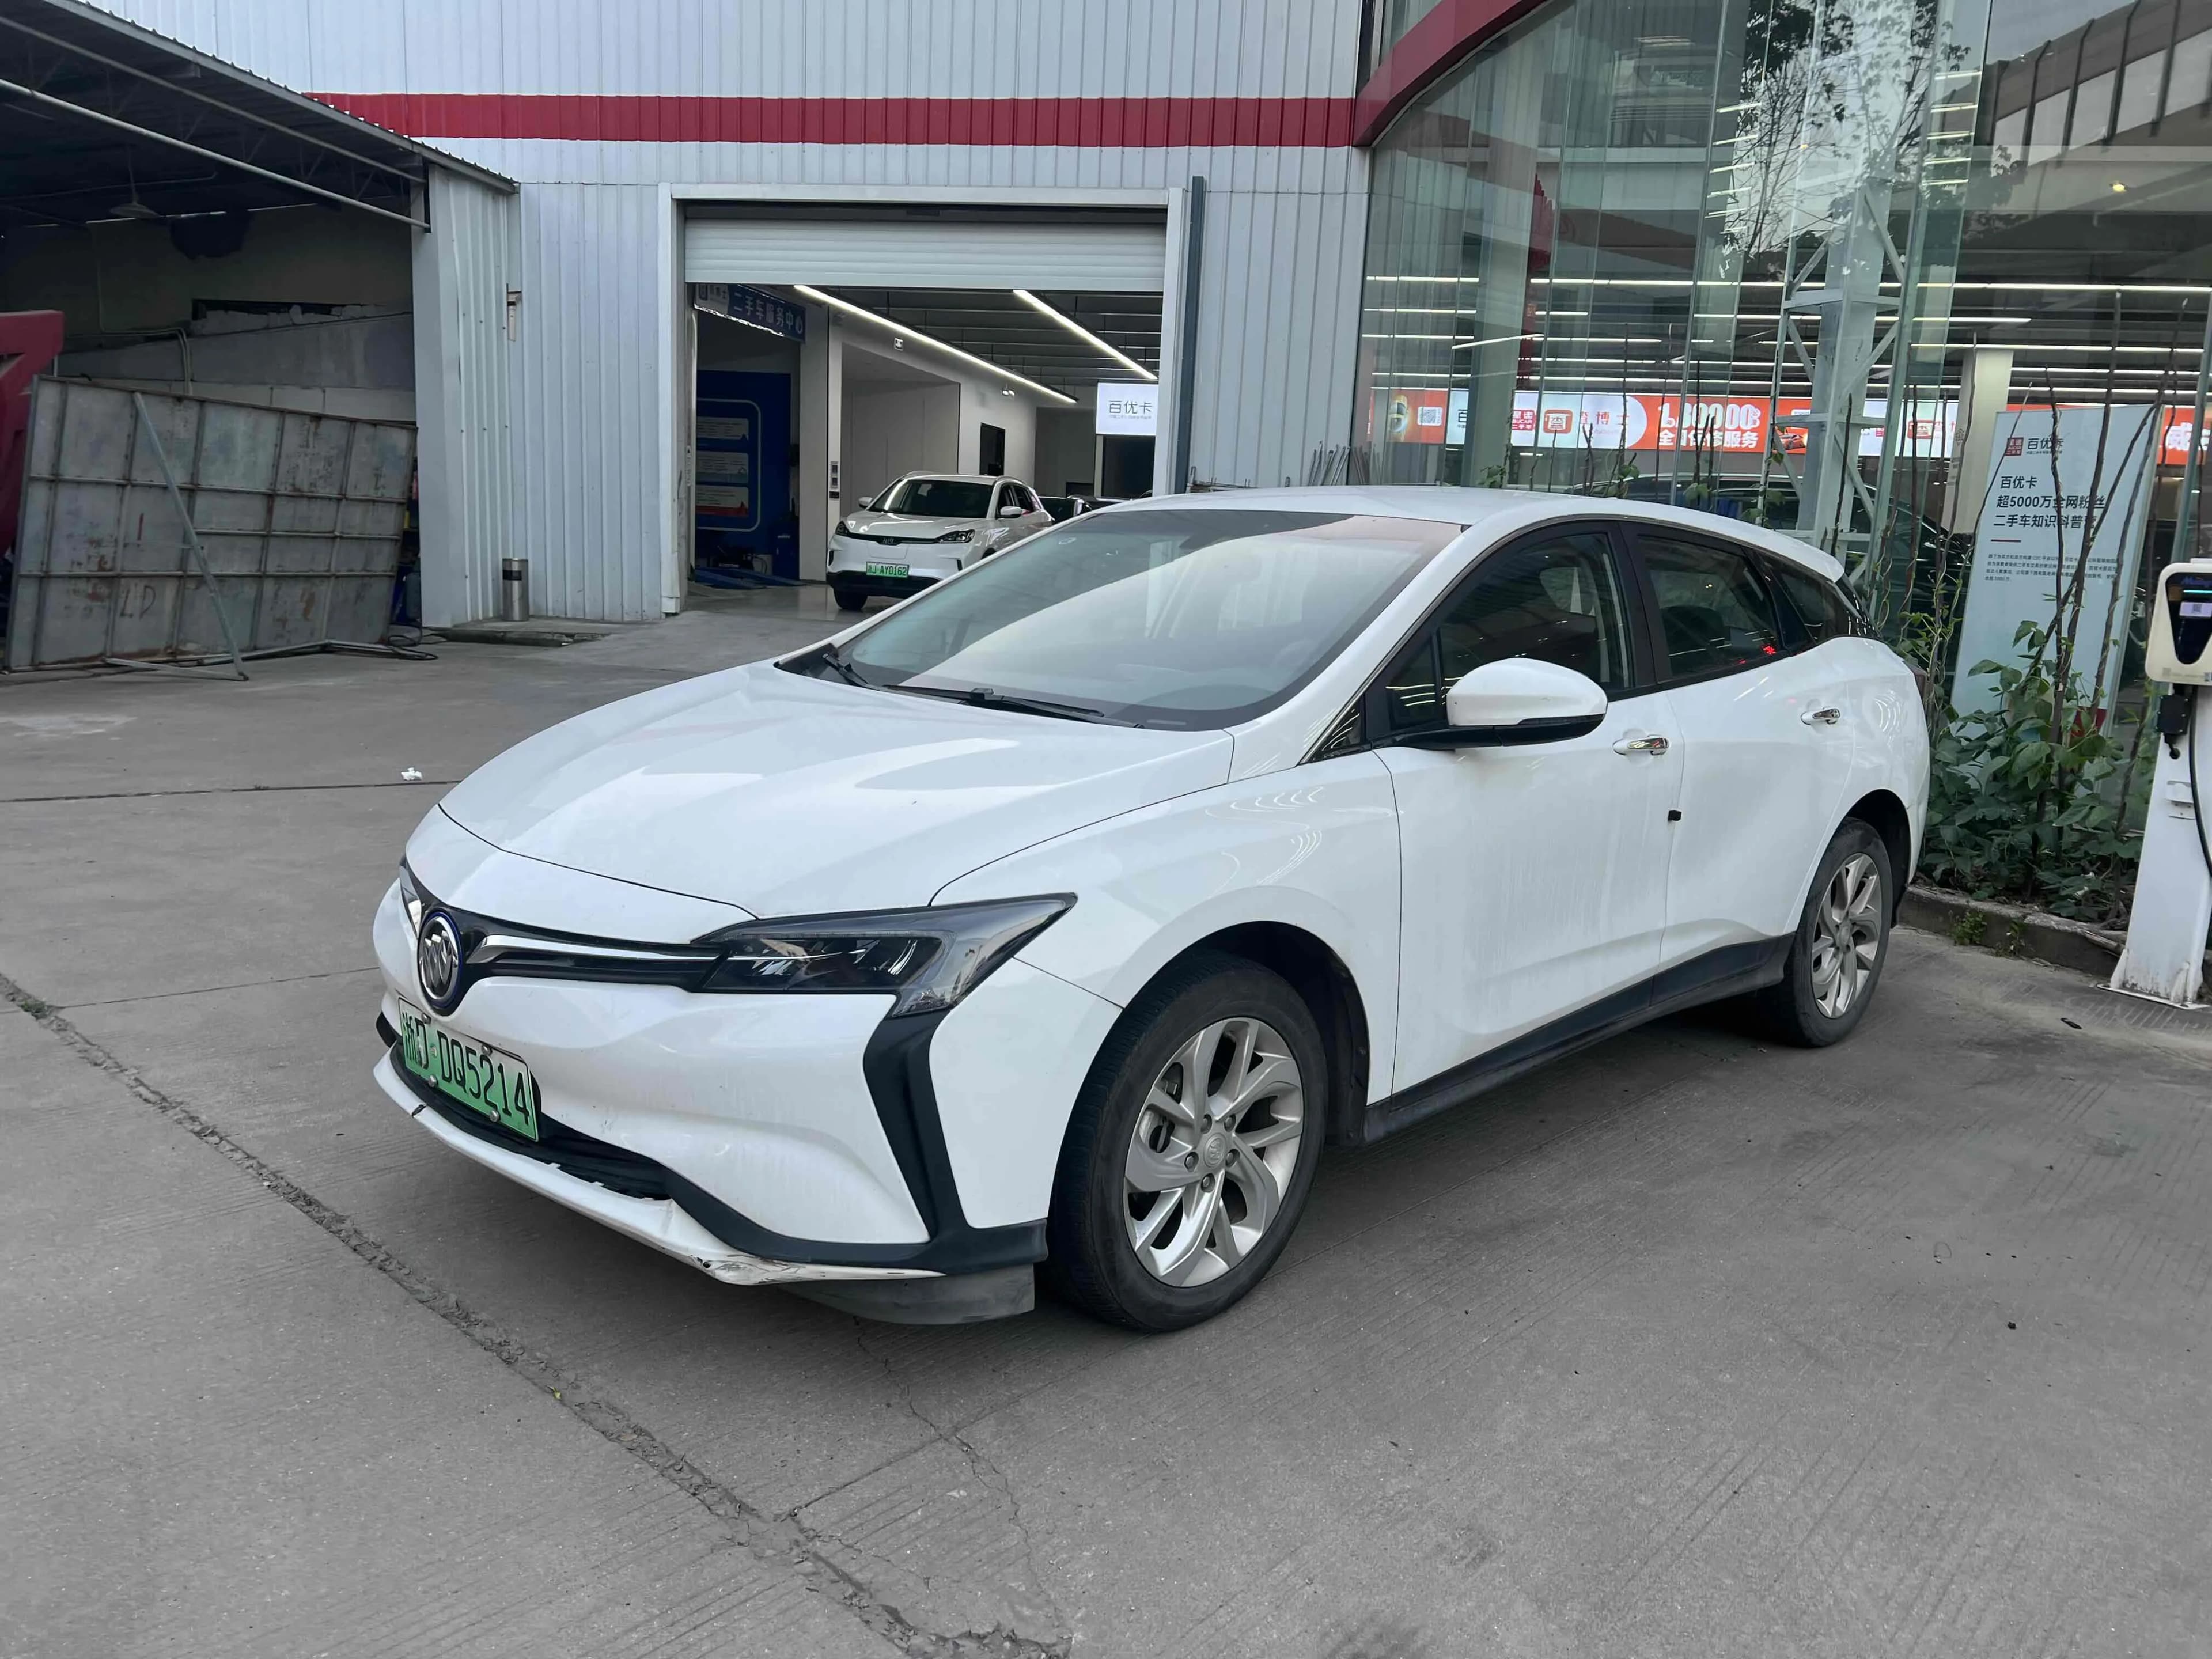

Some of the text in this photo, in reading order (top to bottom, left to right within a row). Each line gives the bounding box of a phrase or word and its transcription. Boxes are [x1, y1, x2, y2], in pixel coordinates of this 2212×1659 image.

[1109, 400, 1153, 414] 百优卡
[2000, 476, 2037, 490] 百优卡
[1996, 495, 2107, 509] 超5000万全网粉丝
